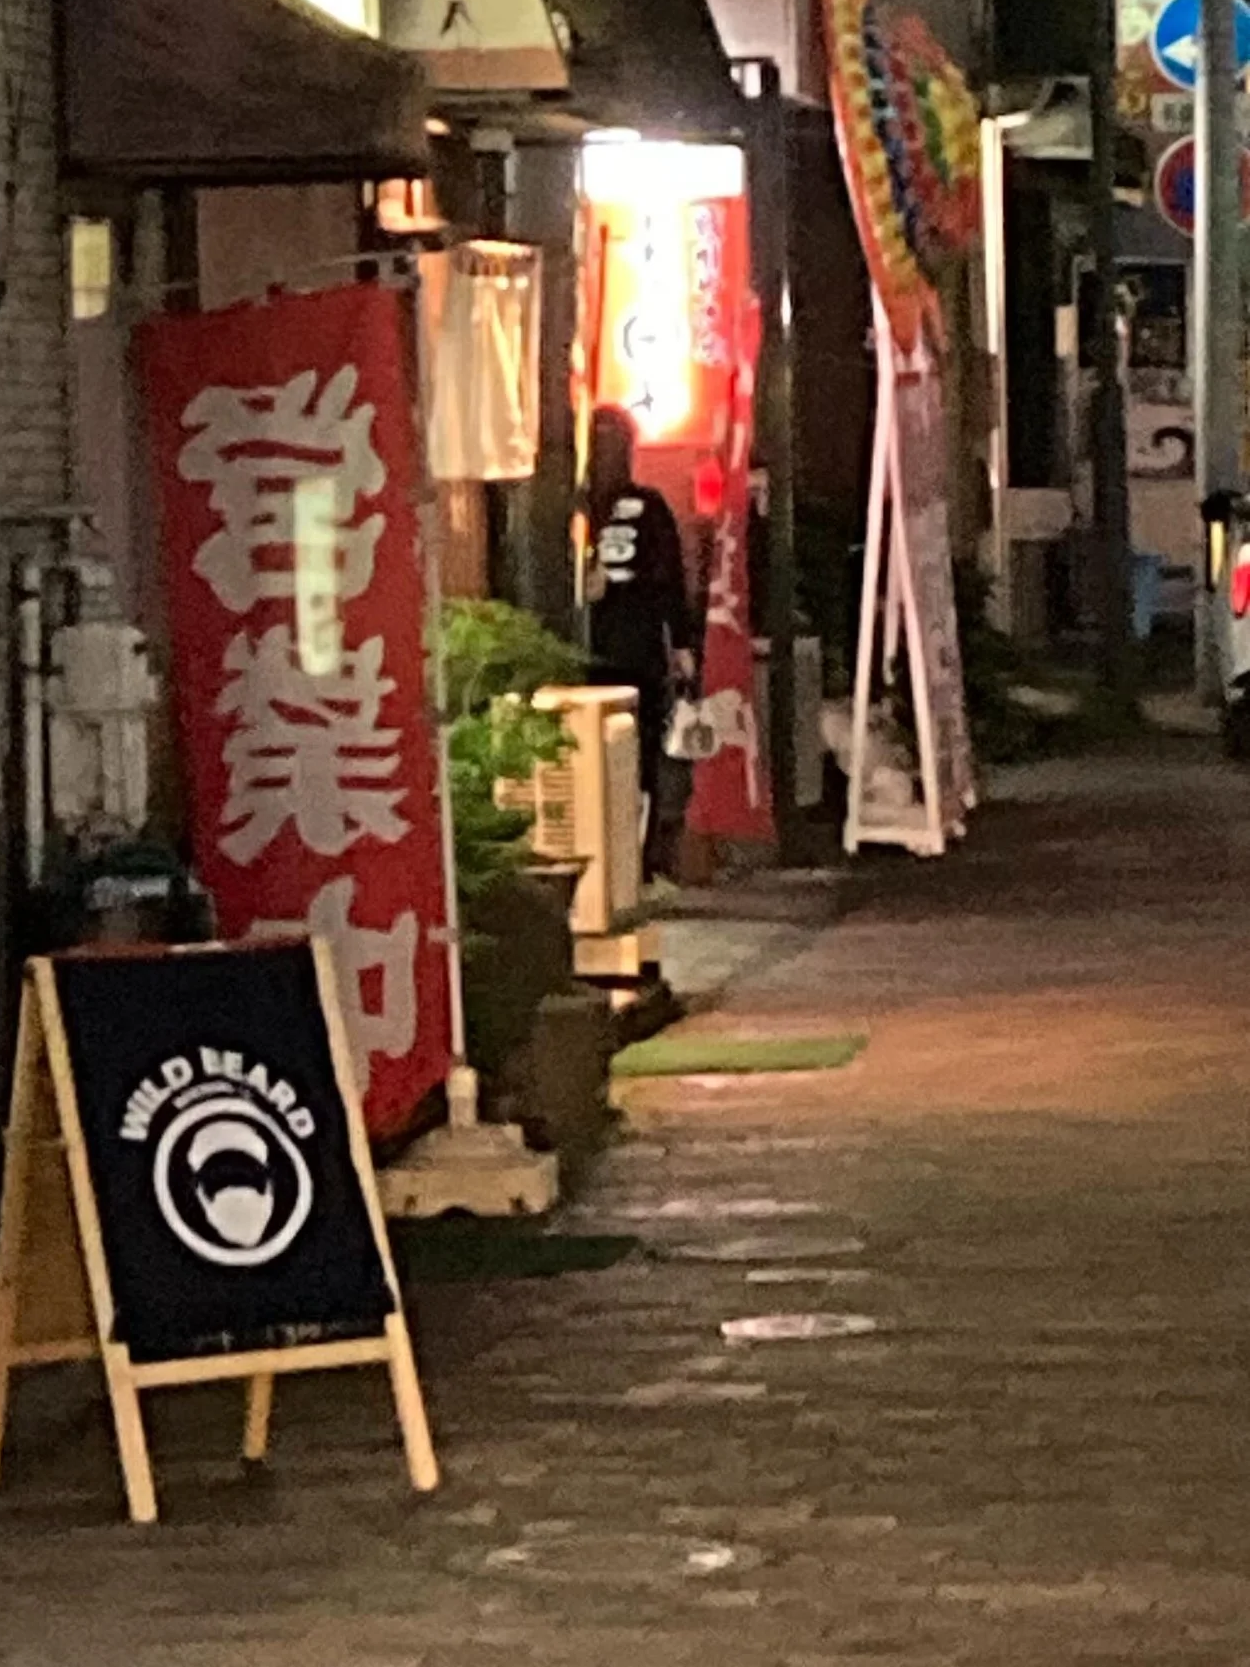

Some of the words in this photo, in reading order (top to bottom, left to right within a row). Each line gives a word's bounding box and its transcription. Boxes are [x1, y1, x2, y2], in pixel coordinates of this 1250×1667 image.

[178, 364, 420, 1104] 営業中
[119, 1055, 194, 1142] WILD
[198, 1044, 316, 1139] BEARD
